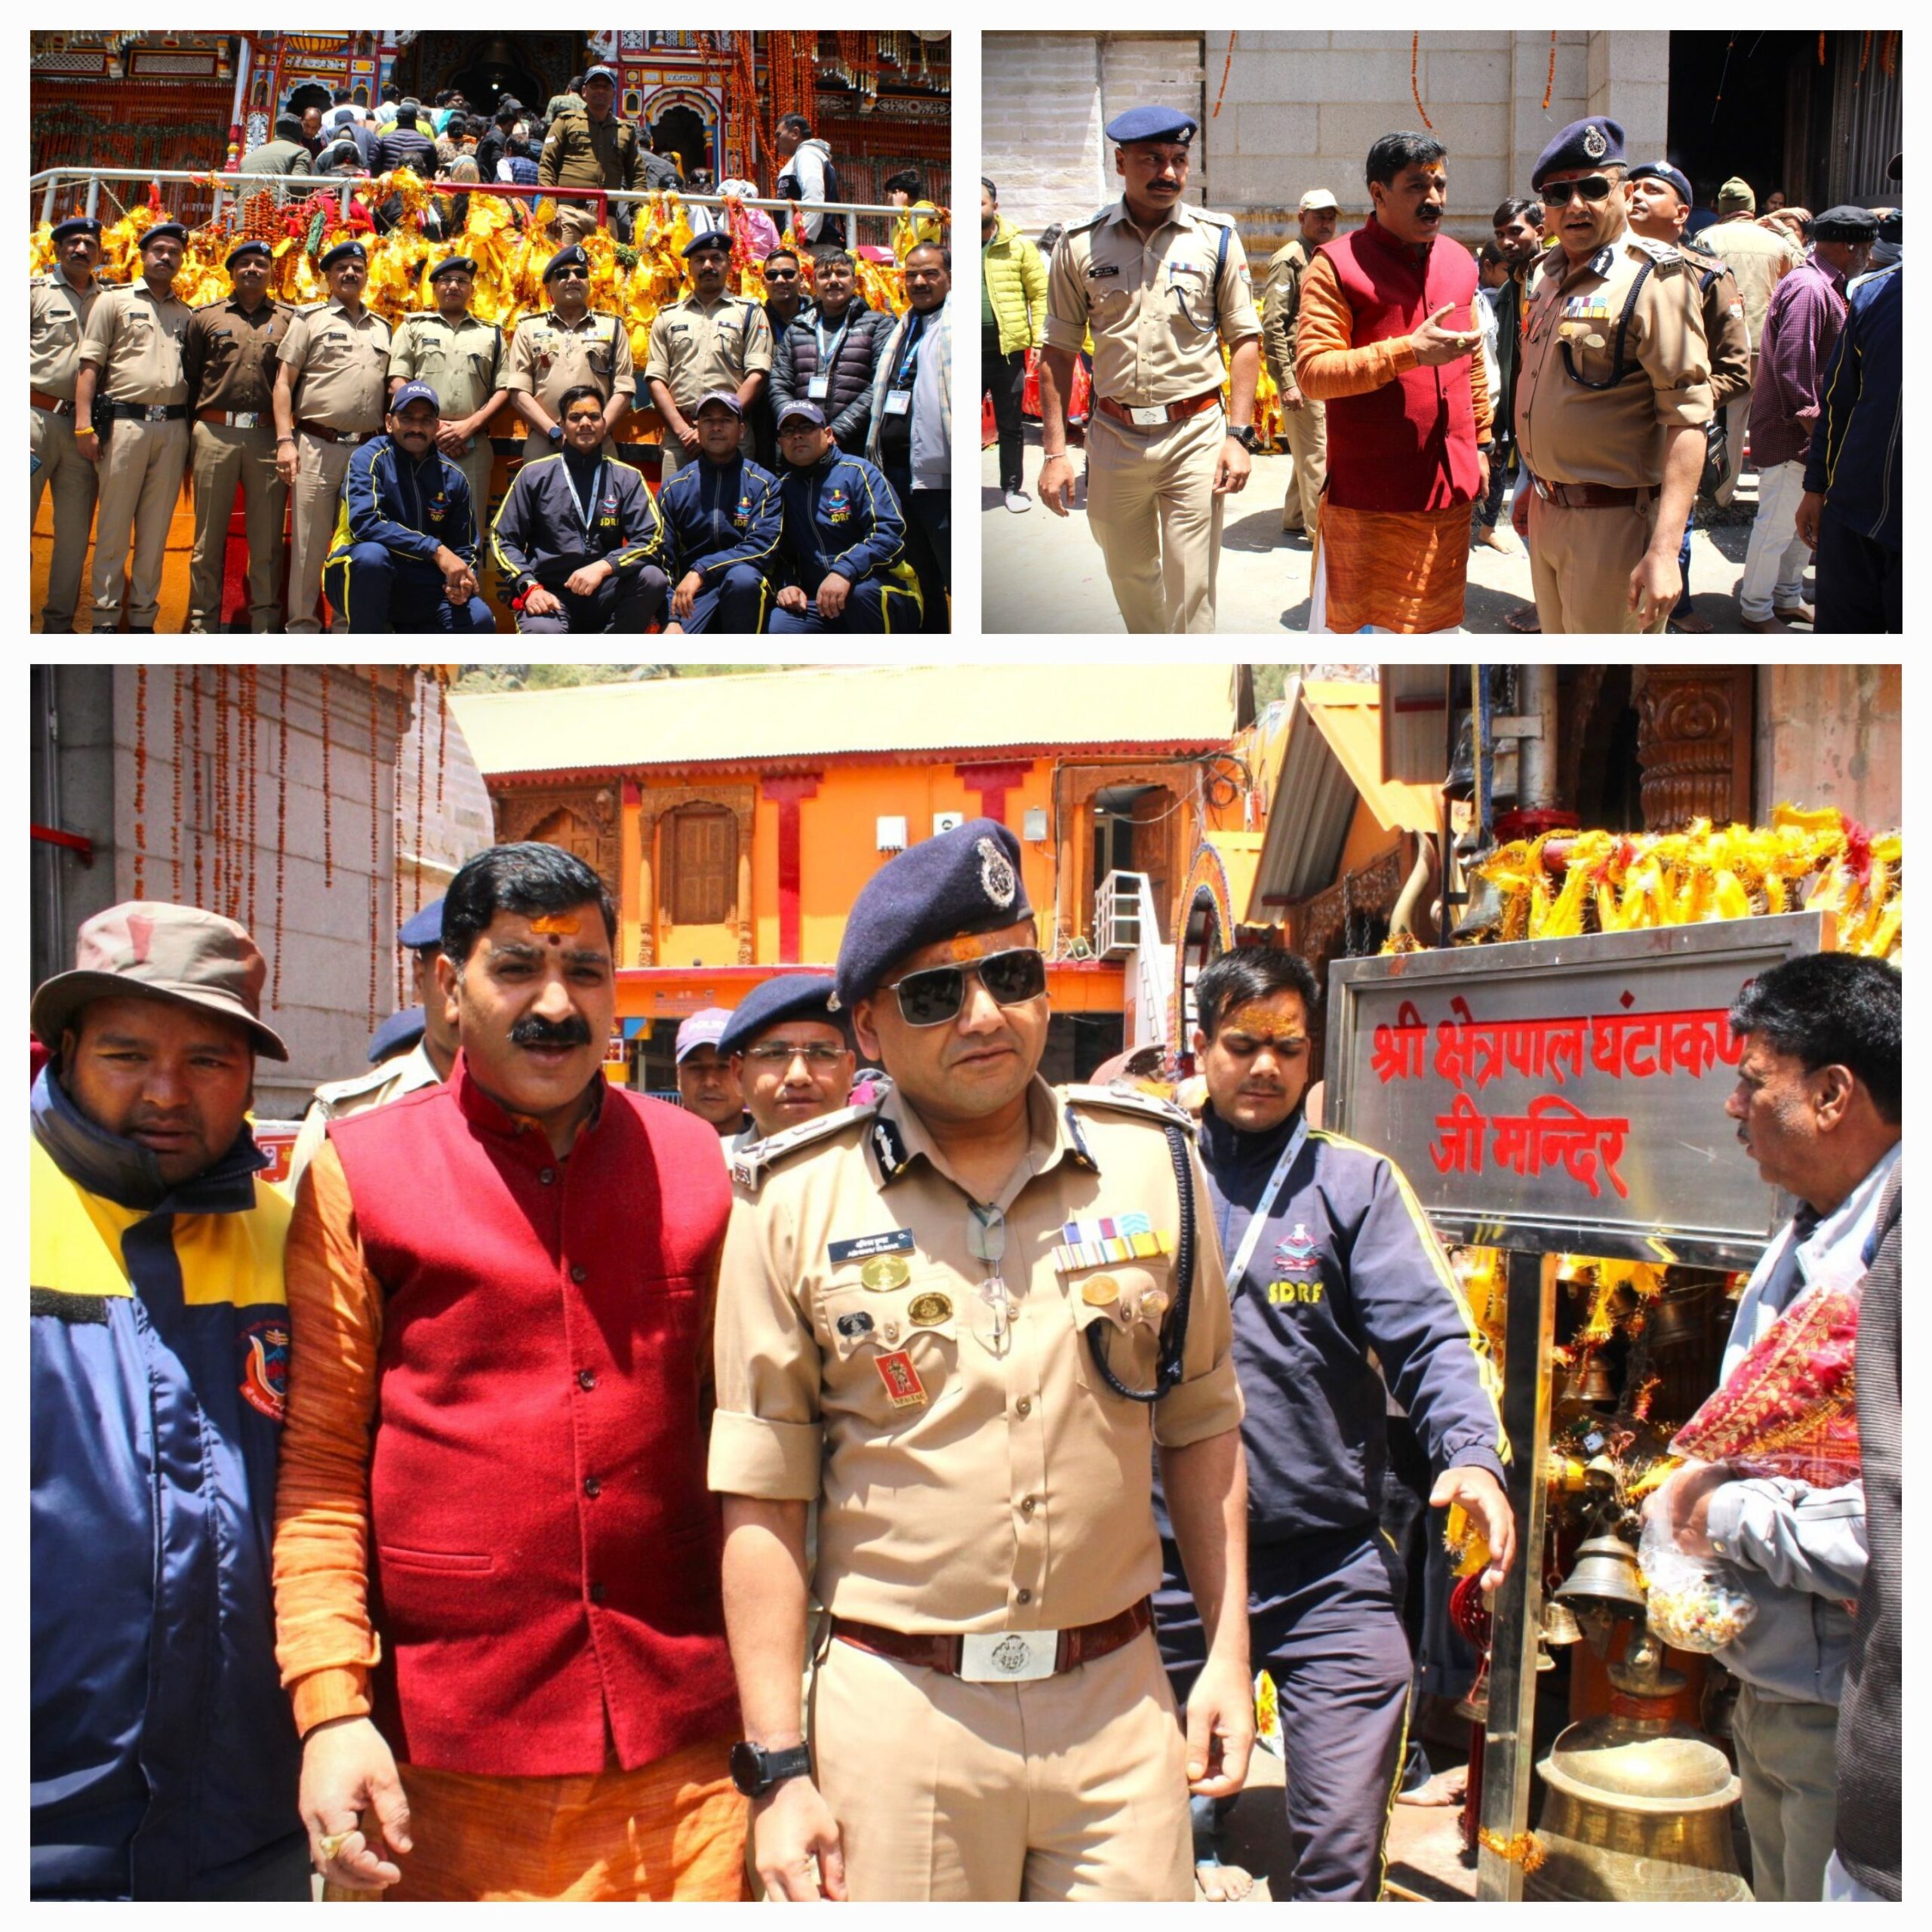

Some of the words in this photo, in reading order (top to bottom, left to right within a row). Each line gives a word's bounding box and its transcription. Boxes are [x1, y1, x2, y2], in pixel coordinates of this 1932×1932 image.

[1371, 1001, 1428, 1084] श्री
[1433, 995, 1589, 1090] क्षेत्रपाल
[1590, 978, 1755, 1079] घंटाक
[1429, 1092, 1487, 1176] जी
[1491, 1094, 1630, 1199] मन्दिर
[1269, 1281, 1324, 1304] SDRF
